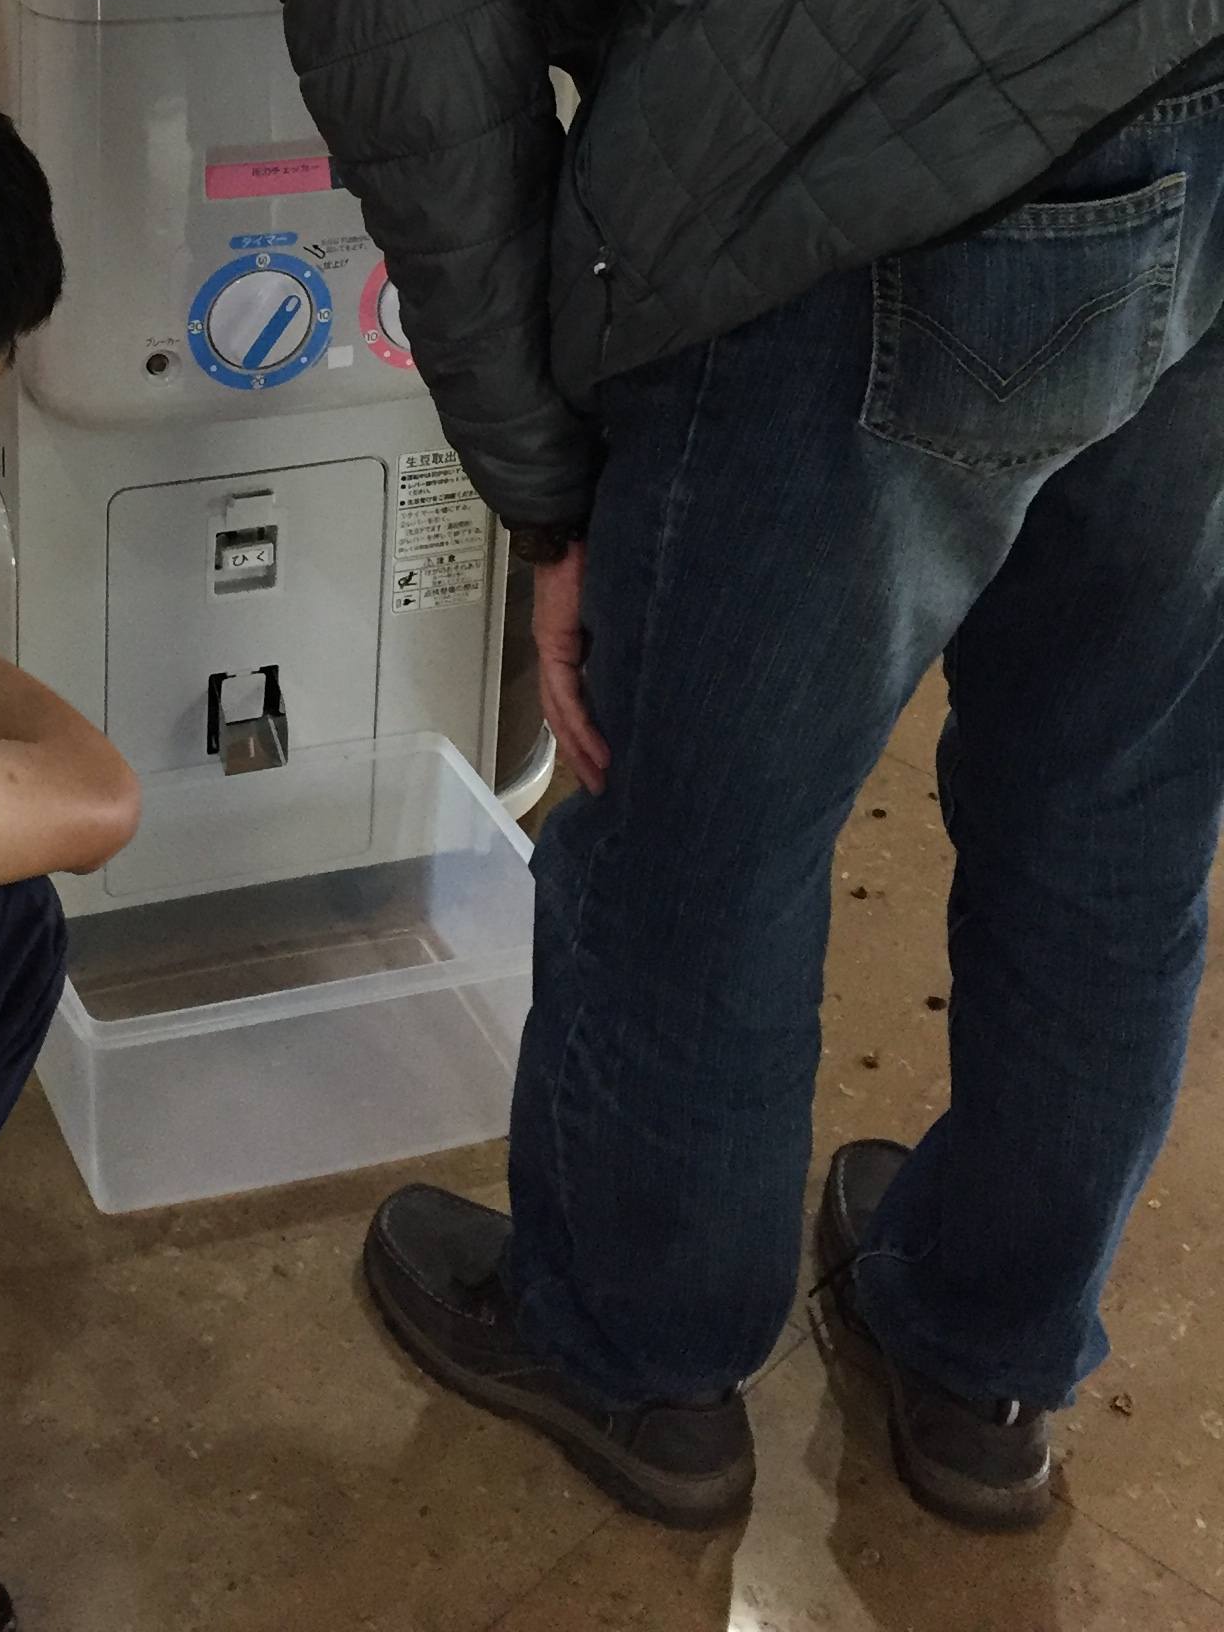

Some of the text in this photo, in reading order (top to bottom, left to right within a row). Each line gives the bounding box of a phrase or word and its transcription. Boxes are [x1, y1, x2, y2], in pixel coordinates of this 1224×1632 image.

[241, 235, 288, 248] タイマー
[319, 310, 331, 321] 10
[365, 332, 378, 343] 10
[231, 550, 265, 567] ひく
